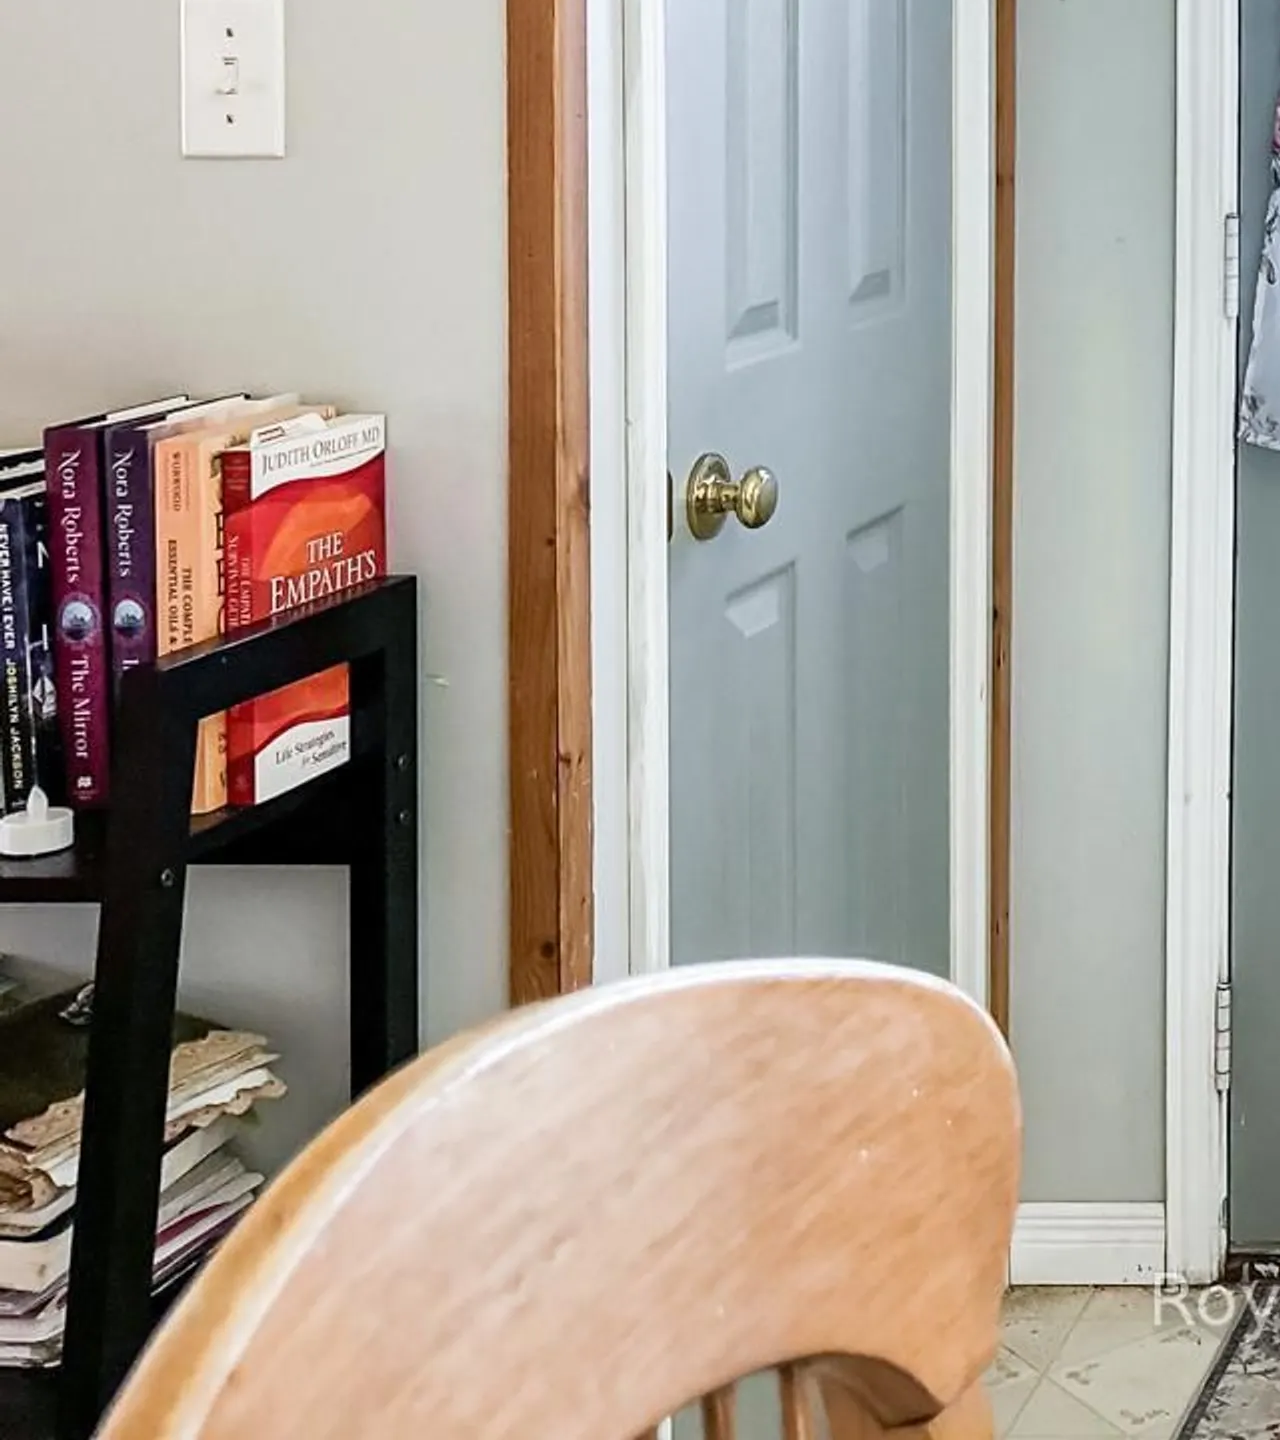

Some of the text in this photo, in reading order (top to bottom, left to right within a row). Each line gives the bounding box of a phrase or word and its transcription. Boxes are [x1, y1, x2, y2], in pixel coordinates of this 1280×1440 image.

[261, 448, 311, 476] JUDITH
[313, 433, 358, 459] ORLOFF
[360, 426, 380, 445] MD
[57, 449, 84, 584] Nora Roberts
[112, 447, 136, 578] Nora Roberts
[168, 539, 178, 603] ESSENTIAL
[306, 531, 344, 563] THE
[1, 569, 13, 604] HAVE
[182, 567, 193, 643] THE COMPLE
[269, 550, 377, 614] EMPATH'S
[3, 614, 16, 650] EVER
[168, 606, 179, 634] OILS
[6, 657, 24, 790] JOSHILYN JACKSON
[70, 653, 91, 759] The Mirror
